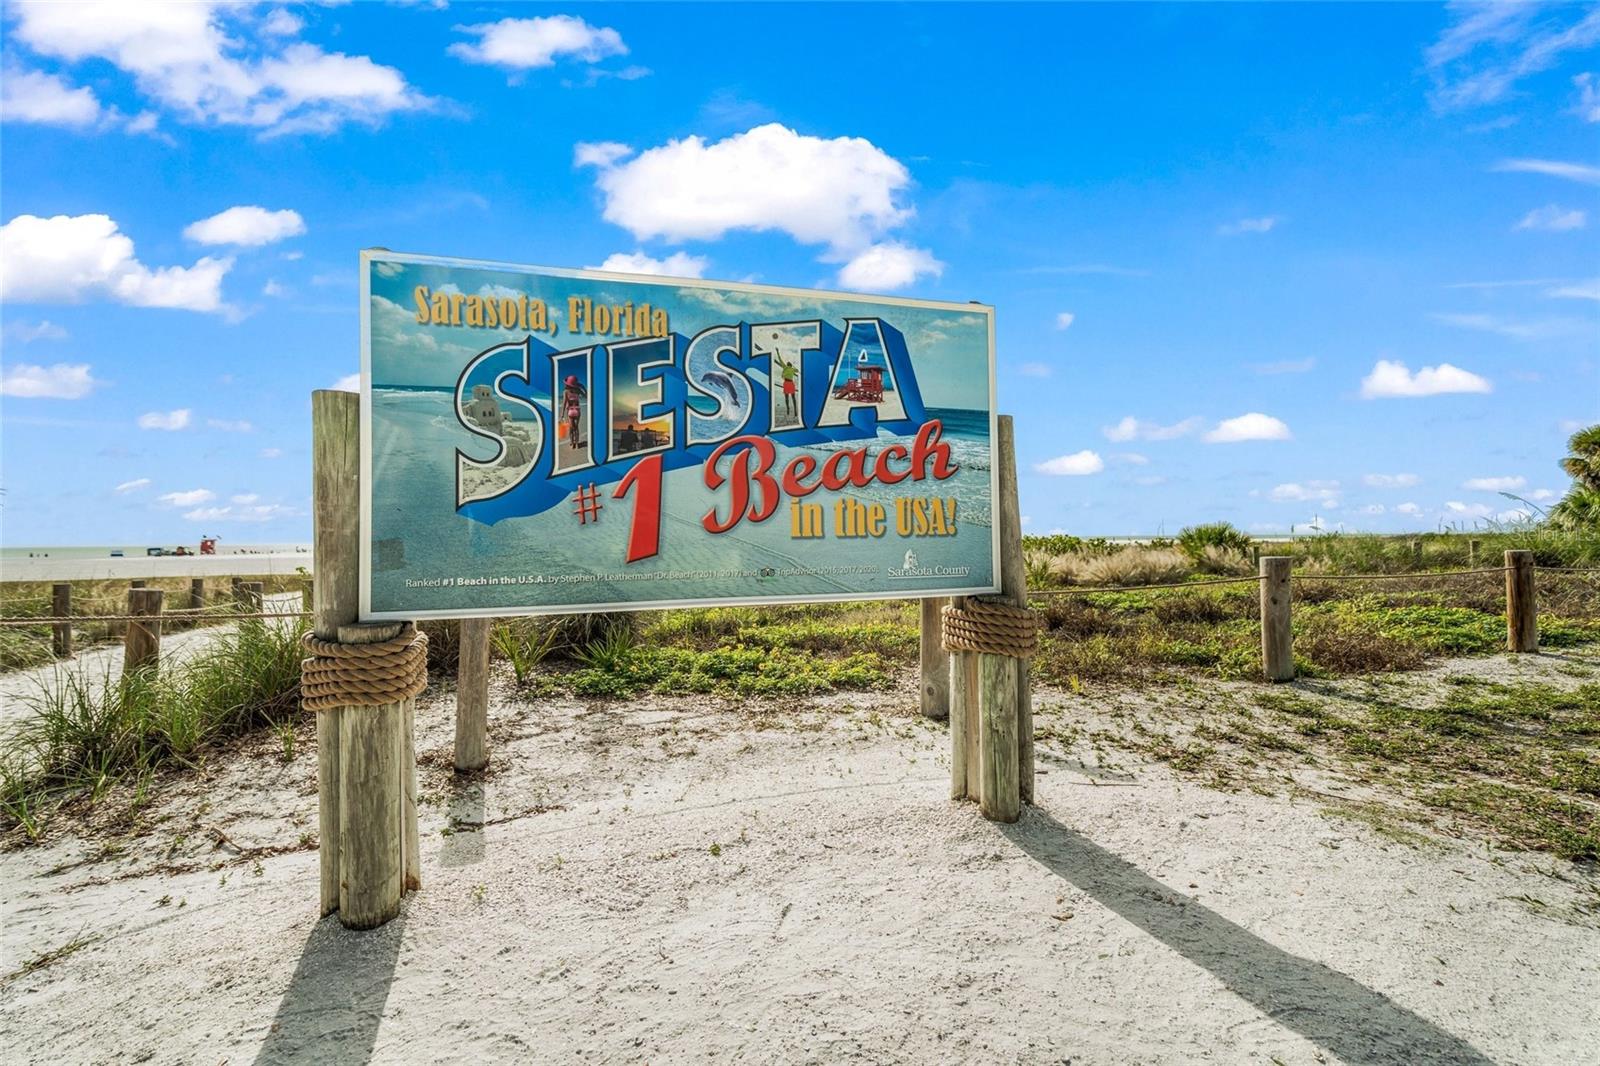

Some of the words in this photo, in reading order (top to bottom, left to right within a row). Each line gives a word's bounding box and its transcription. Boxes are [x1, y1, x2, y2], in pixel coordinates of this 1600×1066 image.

[414, 285, 558, 336] Sarasota,
[568, 297, 669, 337] Florida
[455, 317, 912, 515] SIESTA
[702, 418, 959, 534] Beach
[790, 497, 824, 539] in
[834, 497, 886, 538] the
[896, 497, 958, 537] USA!
[405, 578, 441, 588] Ranked
[442, 578, 455, 587] #1
[457, 577, 487, 586] Beach
[489, 576, 499, 585] in
[500, 576, 517, 585] the
[518, 575, 547, 584] U.S.A.
[548, 574, 560, 585] by
[560, 573, 595, 585] Stephen
[887, 566, 933, 577] Sarasota
[935, 565, 971, 576] County
